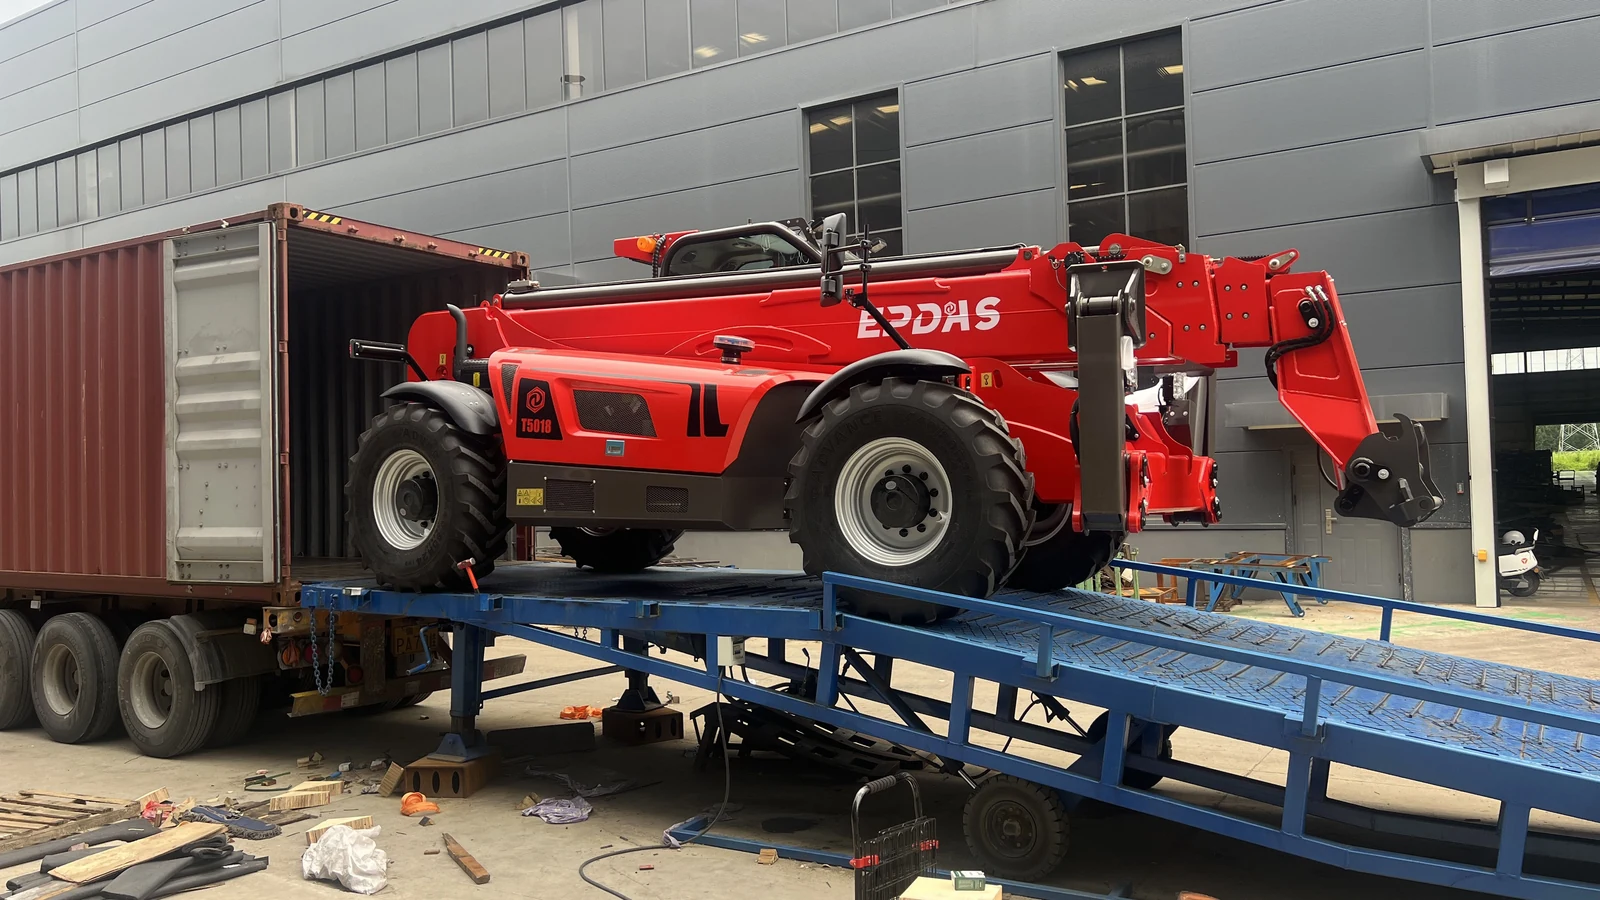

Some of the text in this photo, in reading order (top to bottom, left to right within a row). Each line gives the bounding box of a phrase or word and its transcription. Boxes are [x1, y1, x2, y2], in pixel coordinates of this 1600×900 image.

[857, 297, 1001, 338] EPDAS
[521, 418, 552, 433] T5018
[812, 409, 884, 483] ADVANCE
